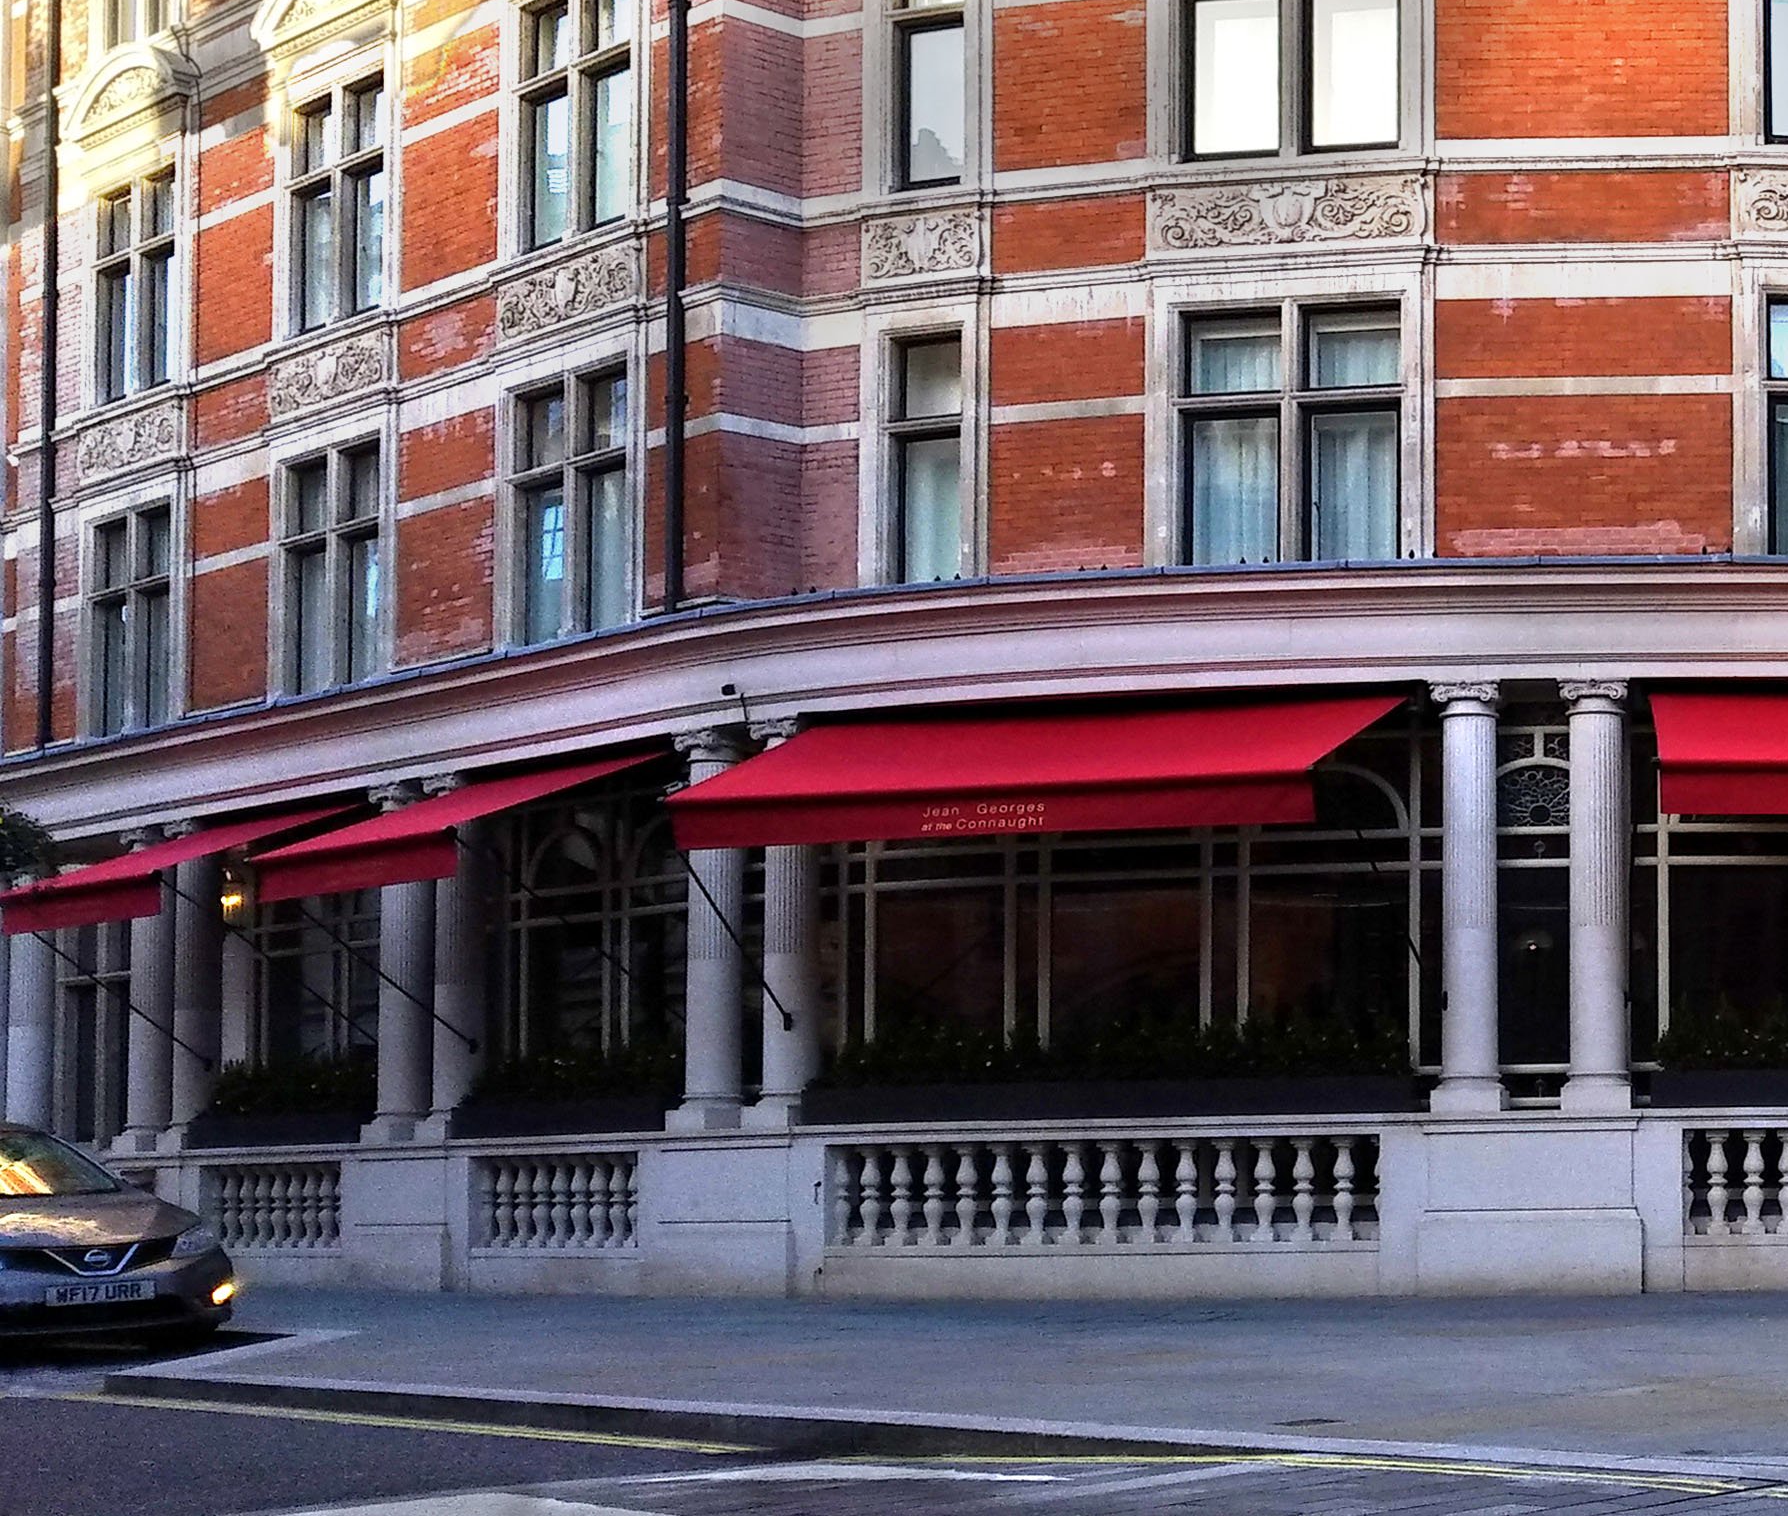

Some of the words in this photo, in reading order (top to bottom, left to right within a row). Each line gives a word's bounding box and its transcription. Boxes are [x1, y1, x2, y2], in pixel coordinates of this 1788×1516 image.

[922, 806, 960, 818] Jean
[976, 803, 1045, 815] Georges
[935, 822, 953, 831] the
[956, 816, 1043, 830] Connaught
[56, 1285, 99, 1303] WF17
[104, 1283, 141, 1300] URR
